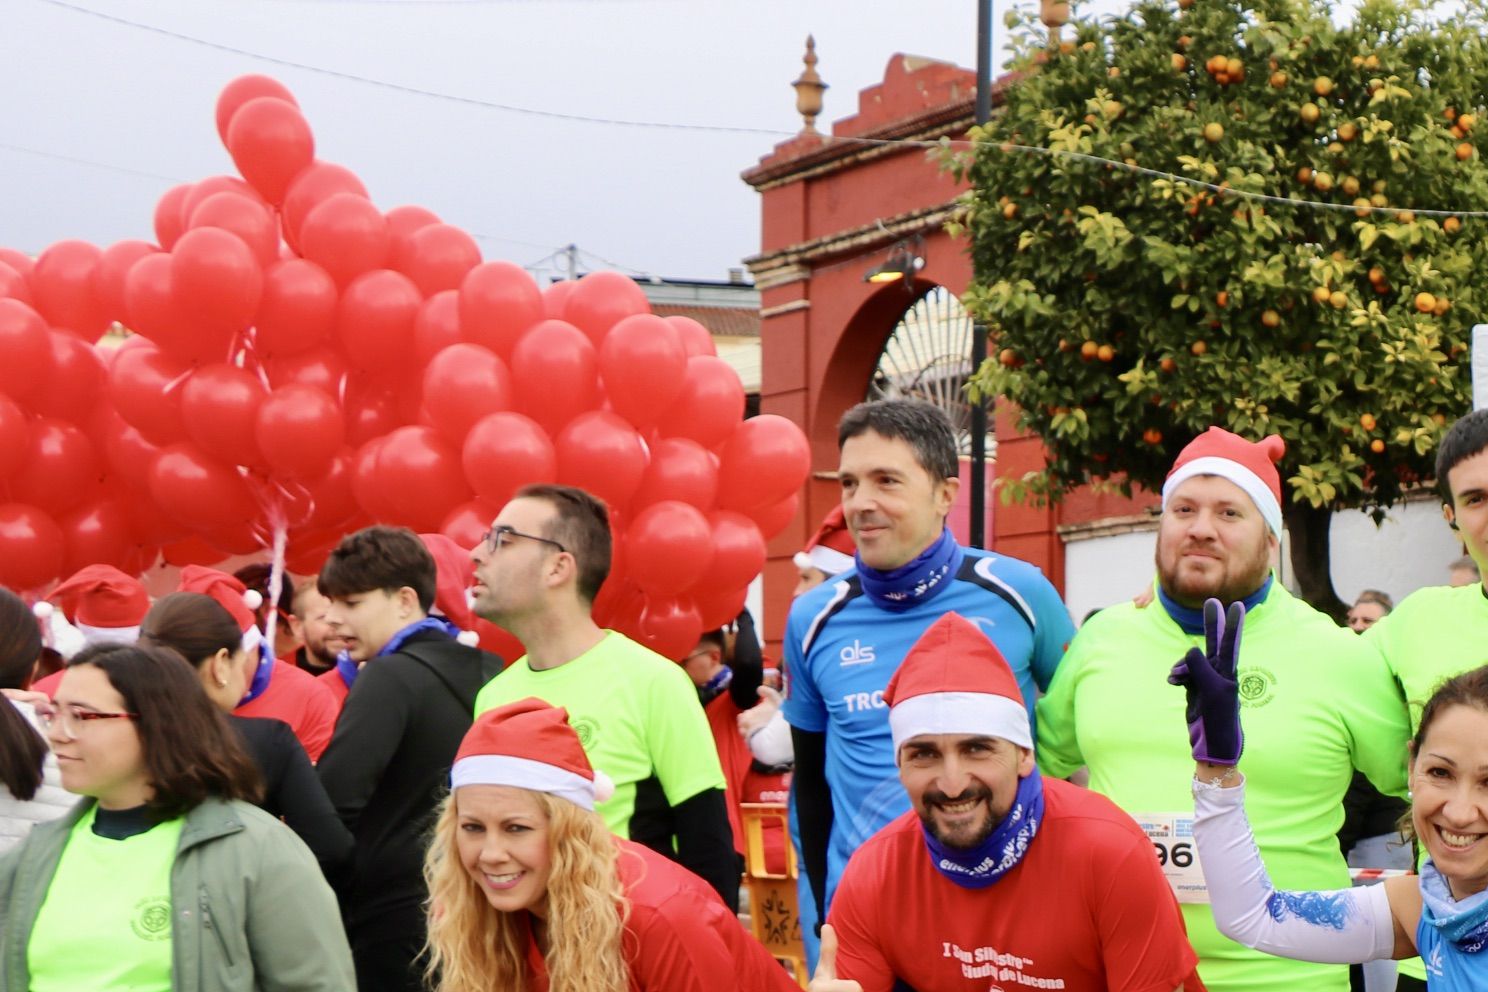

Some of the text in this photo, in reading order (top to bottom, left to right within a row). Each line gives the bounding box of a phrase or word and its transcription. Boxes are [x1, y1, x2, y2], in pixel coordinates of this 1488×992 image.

[840, 639, 876, 665] als
[999, 968, 1016, 981] de
[1017, 972, 1065, 989] Lucena
